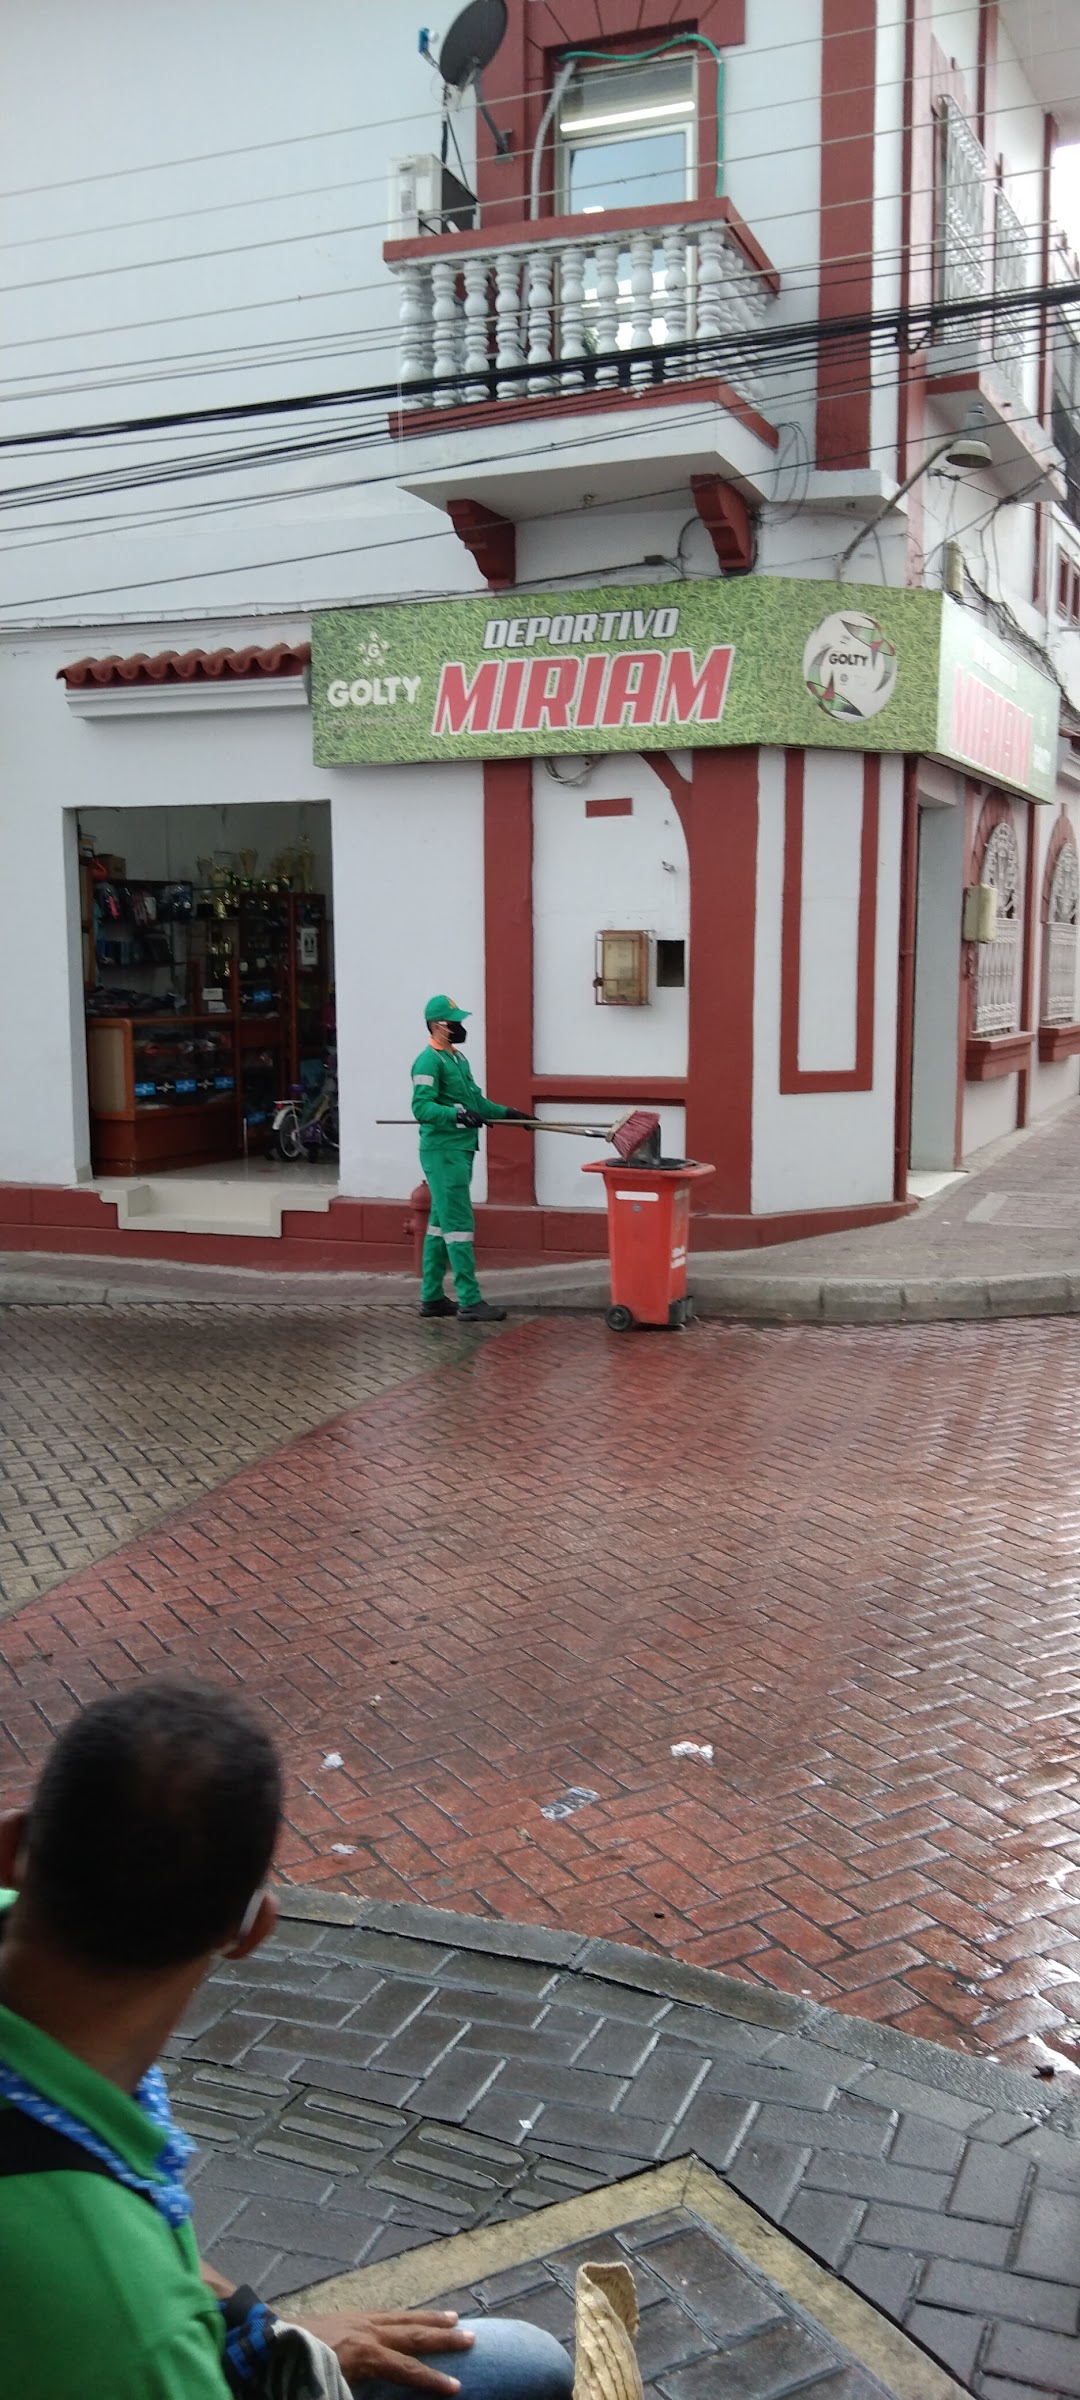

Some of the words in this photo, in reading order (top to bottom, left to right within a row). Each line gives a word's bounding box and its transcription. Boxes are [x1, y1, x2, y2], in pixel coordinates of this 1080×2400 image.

[482, 607, 680, 649] DEPORTIVO
[368, 643, 380, 658] G
[829, 653, 868, 666] GOLTY
[327, 675, 421, 707] GOLTY
[432, 644, 735, 735] MIRIAM
